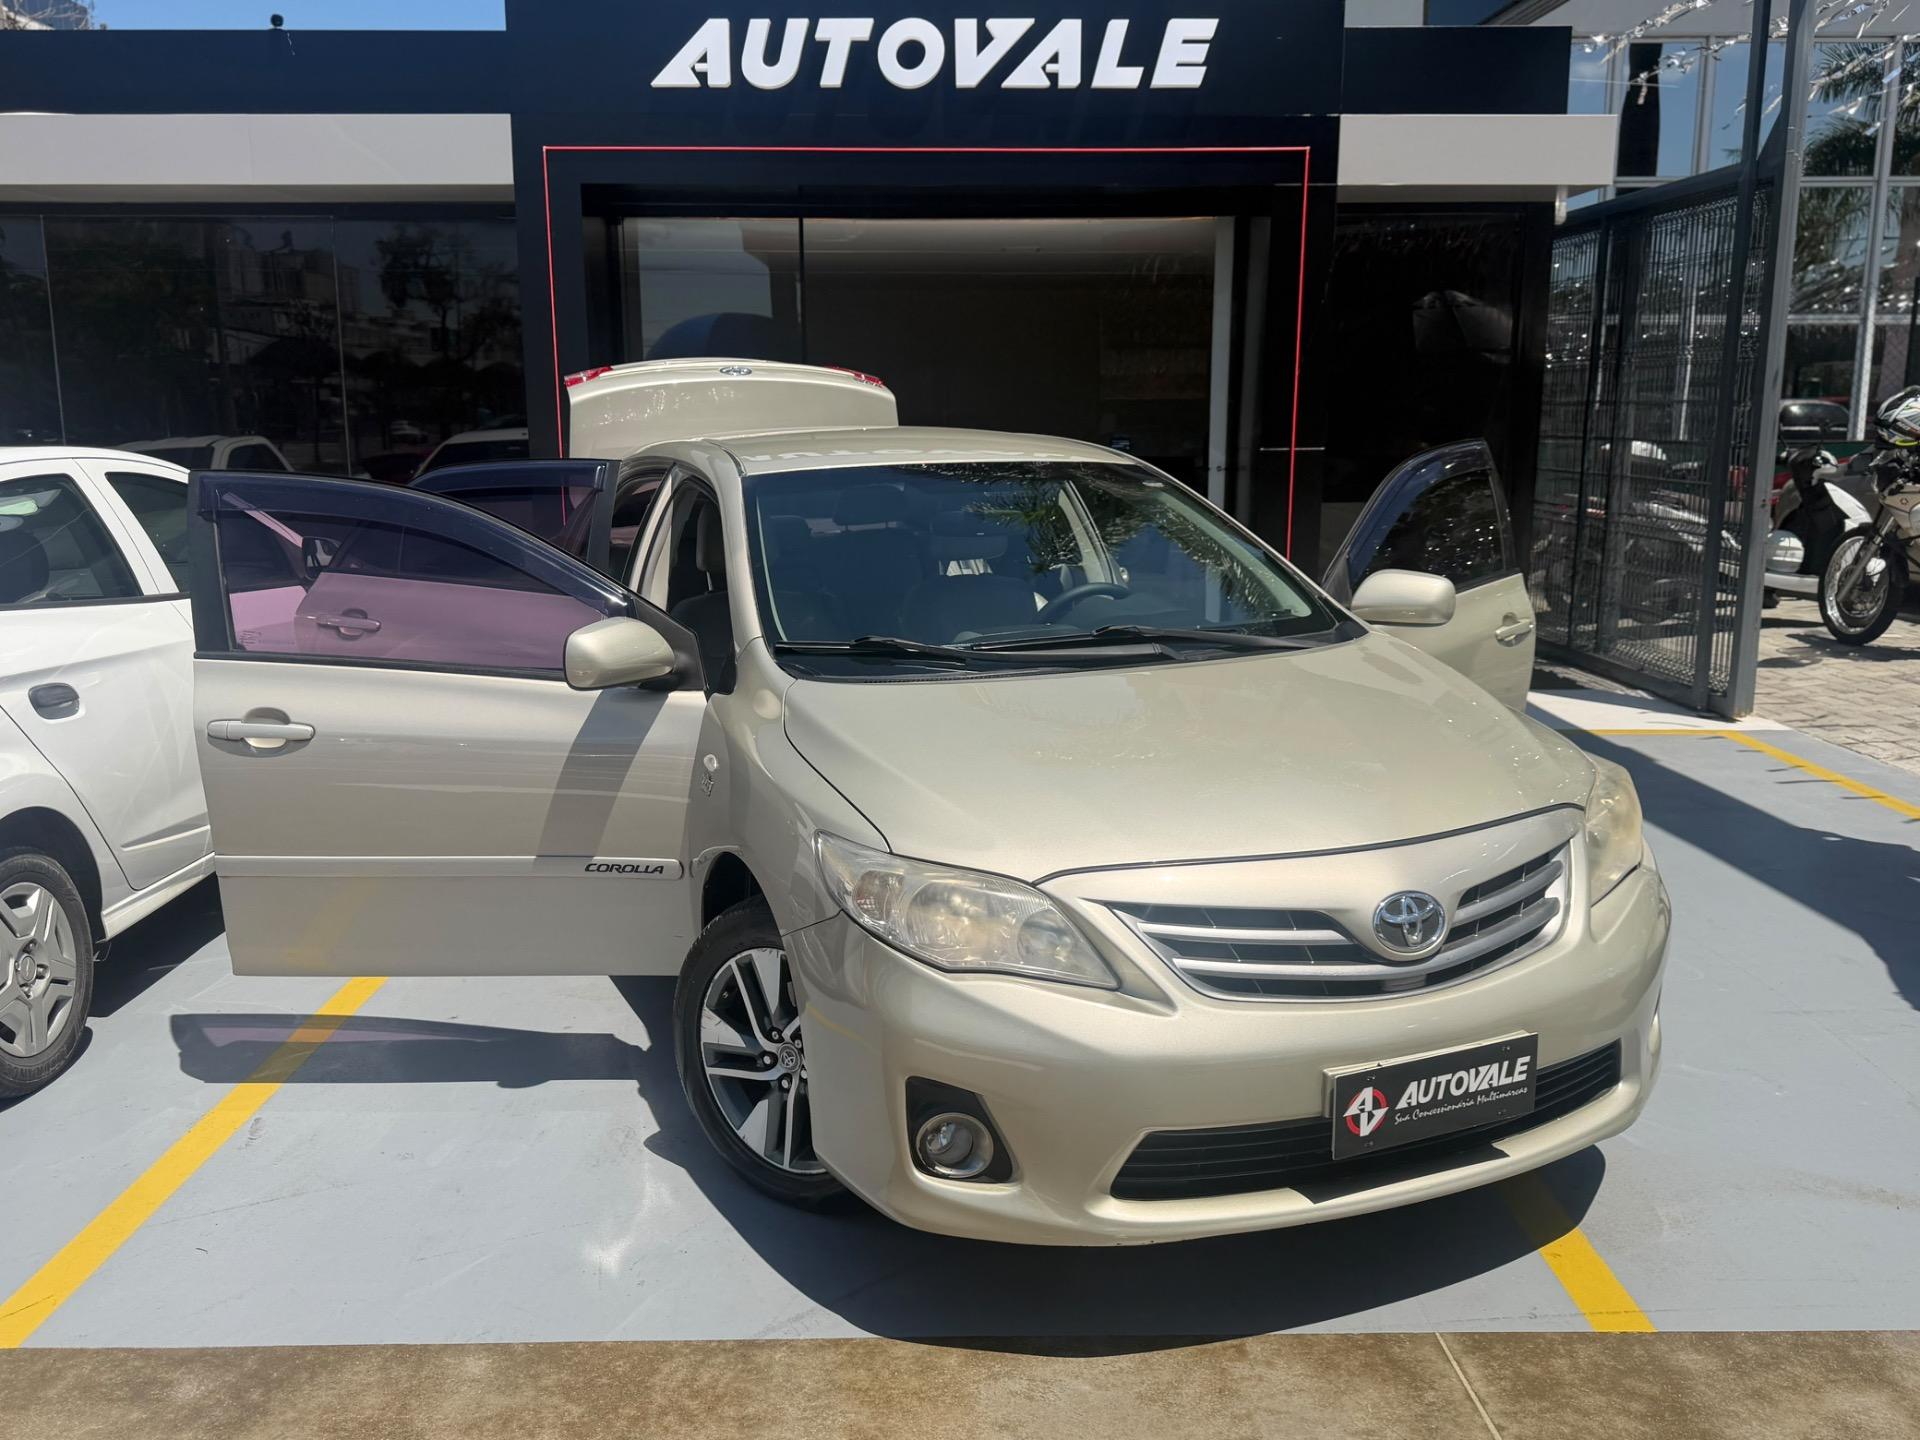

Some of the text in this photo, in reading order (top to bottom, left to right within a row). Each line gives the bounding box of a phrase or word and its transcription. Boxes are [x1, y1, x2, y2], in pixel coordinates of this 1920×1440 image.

[650, 17, 1220, 89] AUTOVALE
[584, 863, 664, 874] COROLLA
[1394, 1112, 1411, 1125] Sua
[1476, 1086, 1528, 1106] Multimarcas
[1395, 1056, 1531, 1110] AUTOVALE
